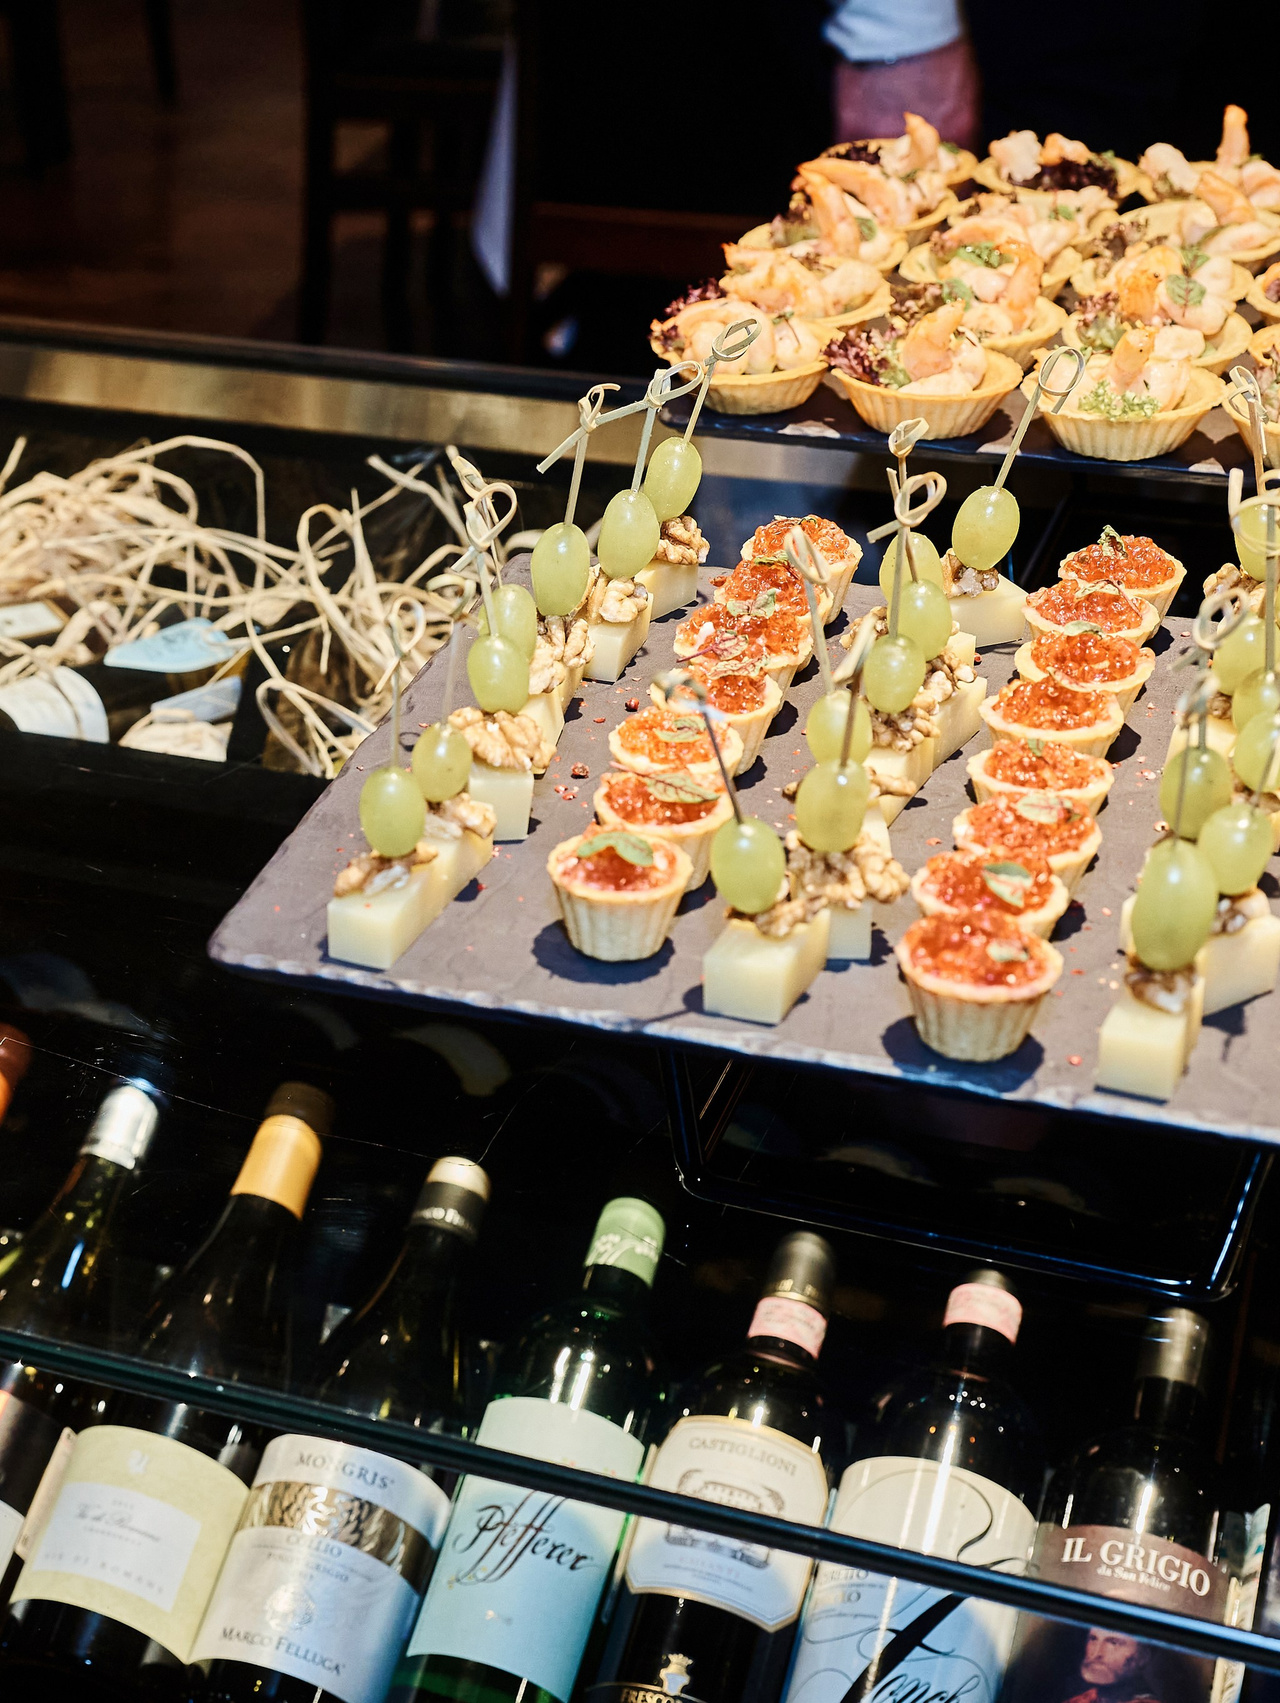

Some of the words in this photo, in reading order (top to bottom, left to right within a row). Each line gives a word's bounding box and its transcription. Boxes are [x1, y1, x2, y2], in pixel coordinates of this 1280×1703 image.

[688, 1437, 799, 1477] CASTIGLIONI
[453, 1490, 596, 1586] Pfefferer
[1061, 1537, 1092, 1563] IL
[1099, 1540, 1211, 1597] GRIGIO
[221, 1627, 273, 1648] MARCO
[274, 1636, 342, 1676] FELLUGA
